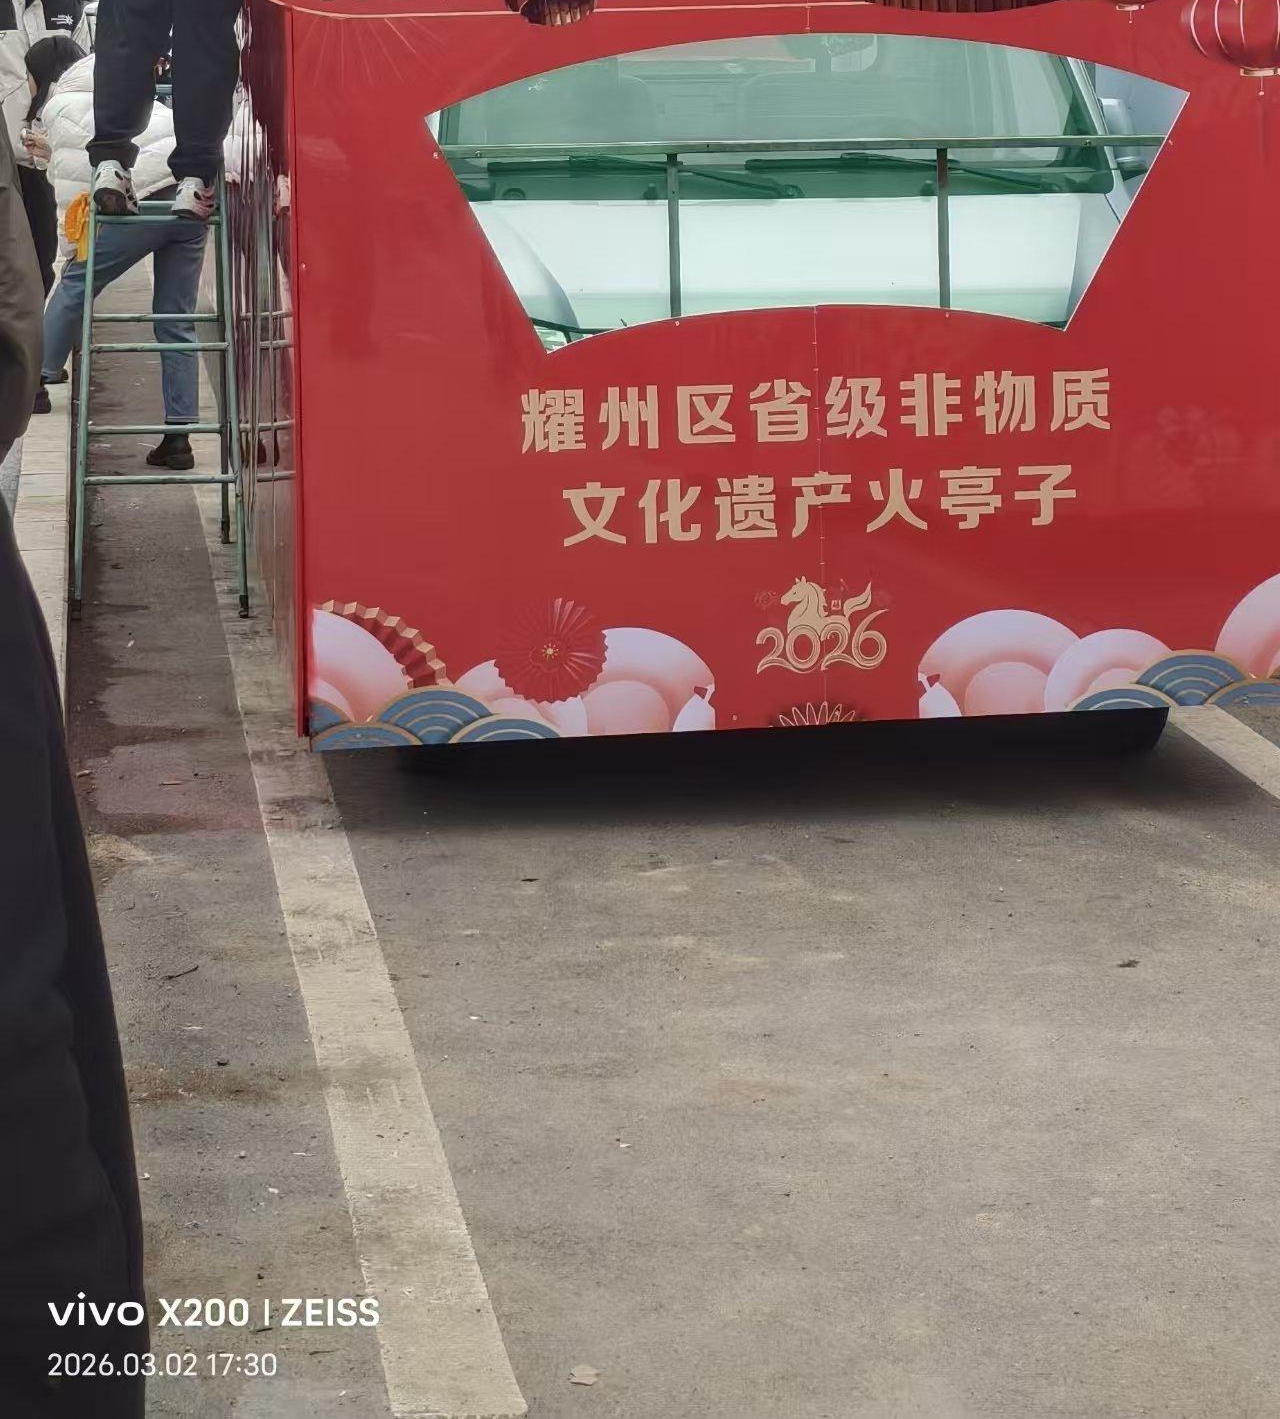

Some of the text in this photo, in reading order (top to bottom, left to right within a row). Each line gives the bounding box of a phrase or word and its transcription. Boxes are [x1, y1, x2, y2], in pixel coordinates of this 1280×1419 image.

[520, 368, 1111, 455] 耀州区省级非物质
[562, 464, 1077, 547] 文化遗产火亭子
[756, 609, 889, 674] 2026
